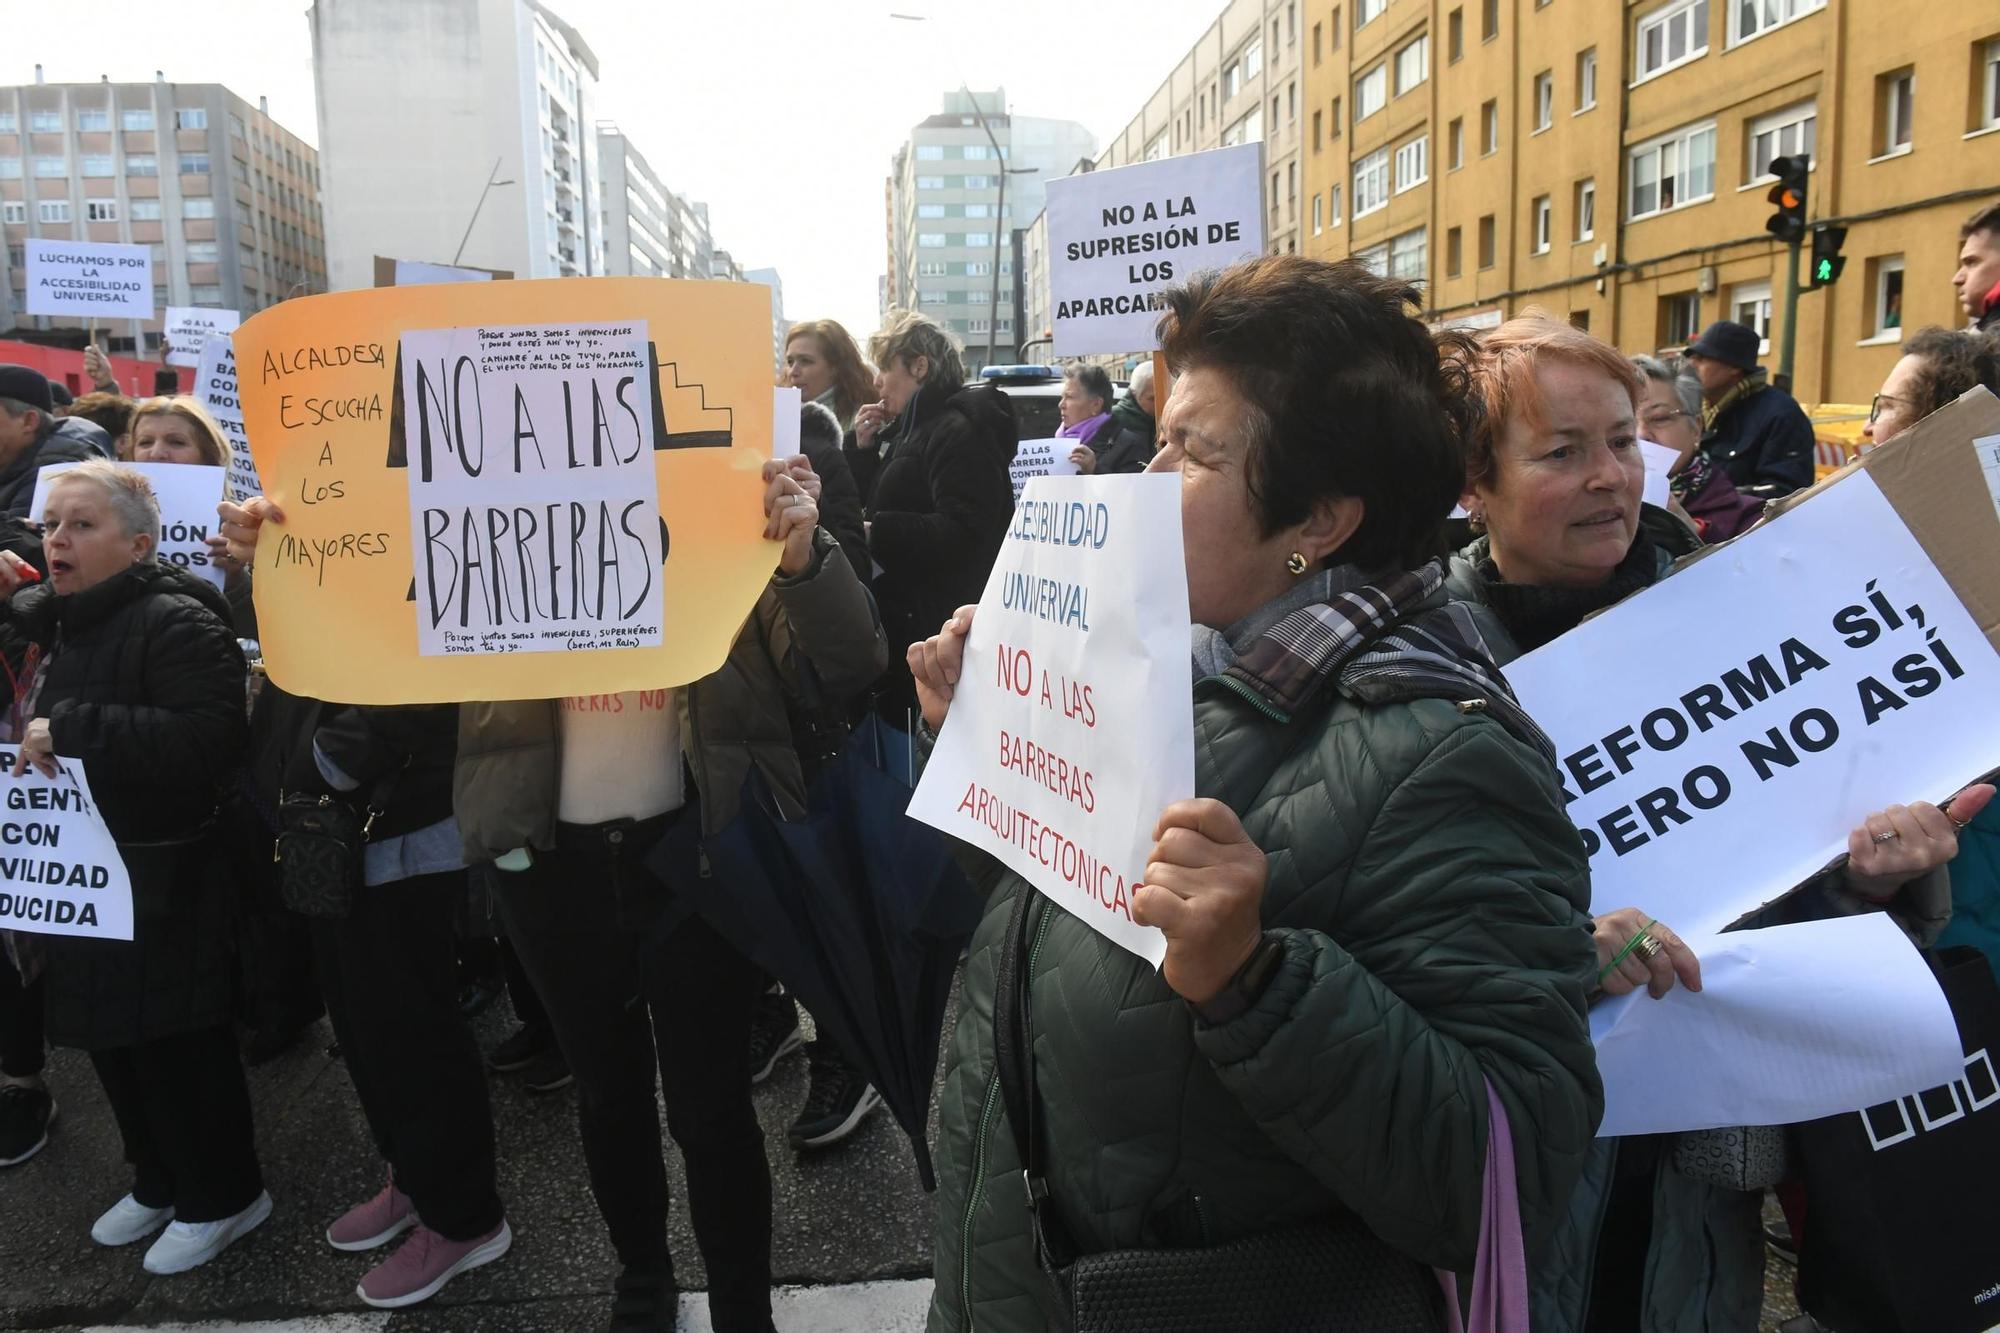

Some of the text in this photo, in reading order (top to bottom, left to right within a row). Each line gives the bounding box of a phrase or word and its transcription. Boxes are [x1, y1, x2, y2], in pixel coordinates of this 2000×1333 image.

[1102, 196, 1196, 227] NO A LA
[1067, 221, 1240, 261] SUPRESIÓN DE
[39, 254, 145, 268] LUCHAMOS POR
[82, 268, 99, 277] LA
[1129, 261, 1173, 283] LOS
[40, 278, 141, 291] ACCESIBILIDAD
[53, 291, 129, 303] UNIVERSAL
[262, 343, 385, 386] ALCALDESA
[280, 392, 384, 429] ESCUCHA
[416, 355, 642, 483] NO A LAS
[318, 441, 333, 466] A
[1010, 457, 1055, 467] ARRERAS
[1031, 446, 1050, 455] LAS
[301, 478, 345, 505] LOS
[275, 532, 391, 587] MAYORES
[423, 499, 652, 630] BARRERAS
[1832, 577, 1926, 649] SÍ,
[997, 642, 1097, 729] NO A LAS
[1739, 707, 1840, 782] NO
[1856, 626, 1966, 727] ASÍ
[1000, 729, 1096, 814] BARRERAS
[1, 822, 60, 848] CON
[0, 857, 109, 889] VILIDAD
[0, 892, 98, 927] DUCIDA
